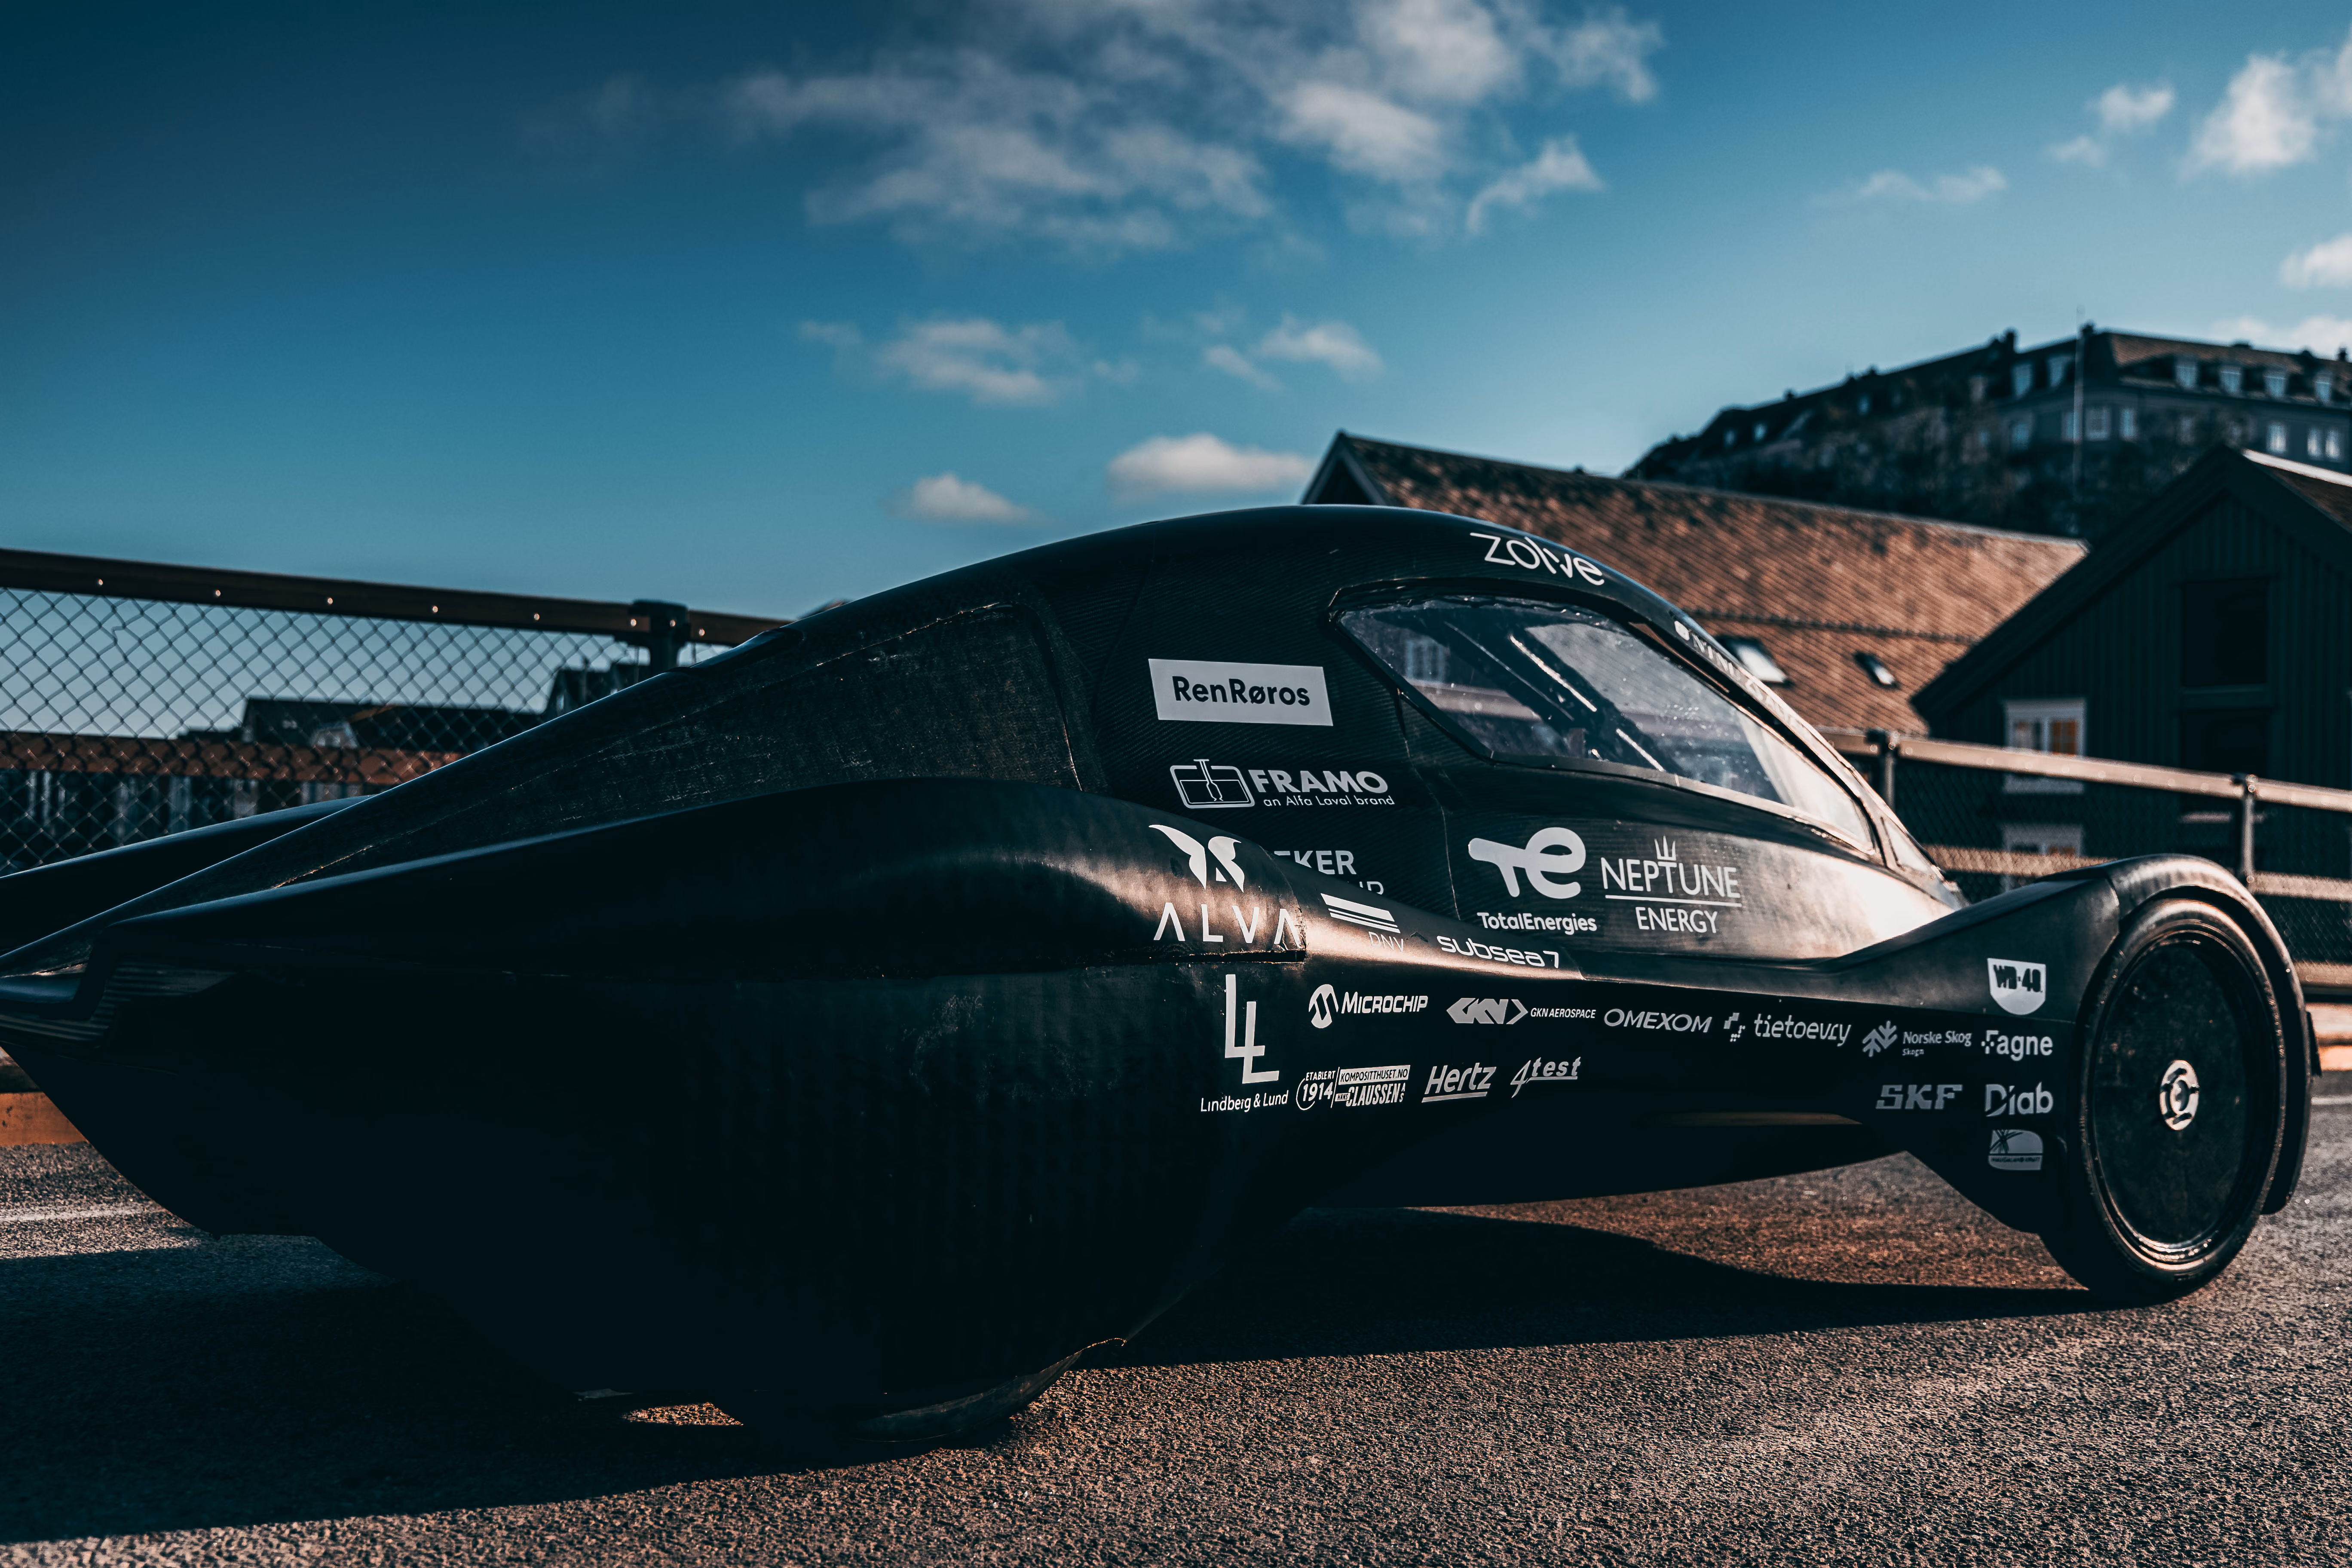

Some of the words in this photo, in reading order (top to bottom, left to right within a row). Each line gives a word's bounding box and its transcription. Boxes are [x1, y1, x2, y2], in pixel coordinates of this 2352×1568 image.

[1172, 676, 1310, 706] RenRøros
[1248, 769, 1388, 794] FRAMO
[1263, 798, 1281, 807] an
[1286, 795, 1313, 806] Alfa
[1315, 795, 1352, 806] Laval
[1353, 795, 1395, 806] brand
[1274, 850, 1357, 875] KER
[1601, 857, 1741, 898] NEPTUNE
[1476, 912, 1598, 935] TotalEnergies
[1635, 906, 1718, 934] ENERGY
[1368, 931, 1404, 953] DNV
[1993, 964, 2042, 993] WD-40
[1530, 1008, 1548, 1017] GKN
[1548, 1008, 1596, 1019] AEROSPACE
[1604, 1008, 1712, 1033] OMEXOM
[1754, 1013, 1852, 1047] tietoevry
[1903, 1031, 1942, 1044] Norske
[1945, 1030, 1972, 1047] Skog
[1305, 1070, 1336, 1081] ETABLERT
[1340, 1068, 1409, 1083] KOMPOSITTHUSET.NO
[1424, 1062, 1497, 1094] Hertz
[1200, 1095, 1251, 1113] Lindberg
[1253, 1093, 1261, 1108] &
[1263, 1090, 1289, 1107] Lund
[1303, 1082, 1333, 1102] 1914
[1337, 1093, 1349, 1101] HANS
[1346, 1083, 1401, 1107] CLAUSSEN
[1875, 1084, 1963, 1109] SKF
[1985, 1081, 2054, 1117] Diab
